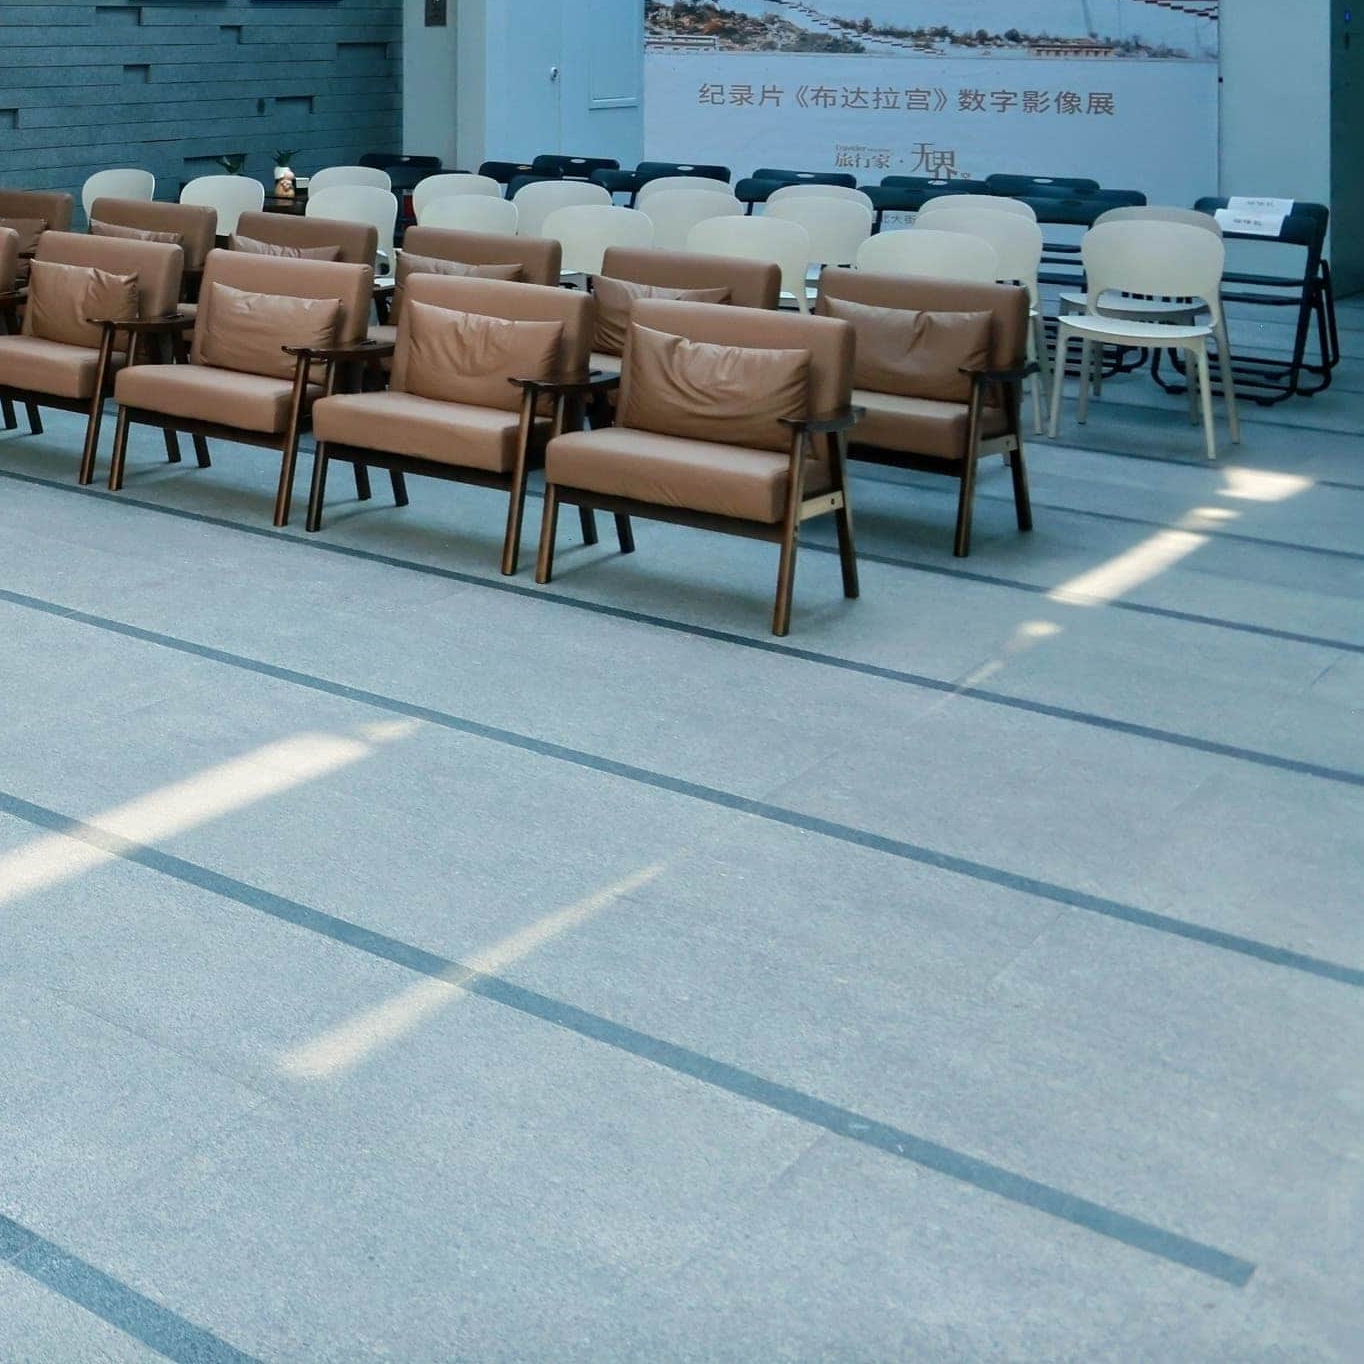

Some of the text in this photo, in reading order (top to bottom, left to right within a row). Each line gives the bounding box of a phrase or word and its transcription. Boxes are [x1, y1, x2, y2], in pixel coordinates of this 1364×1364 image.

[698, 82, 1116, 116] 纪录片《布达拉宫》数字影像展
